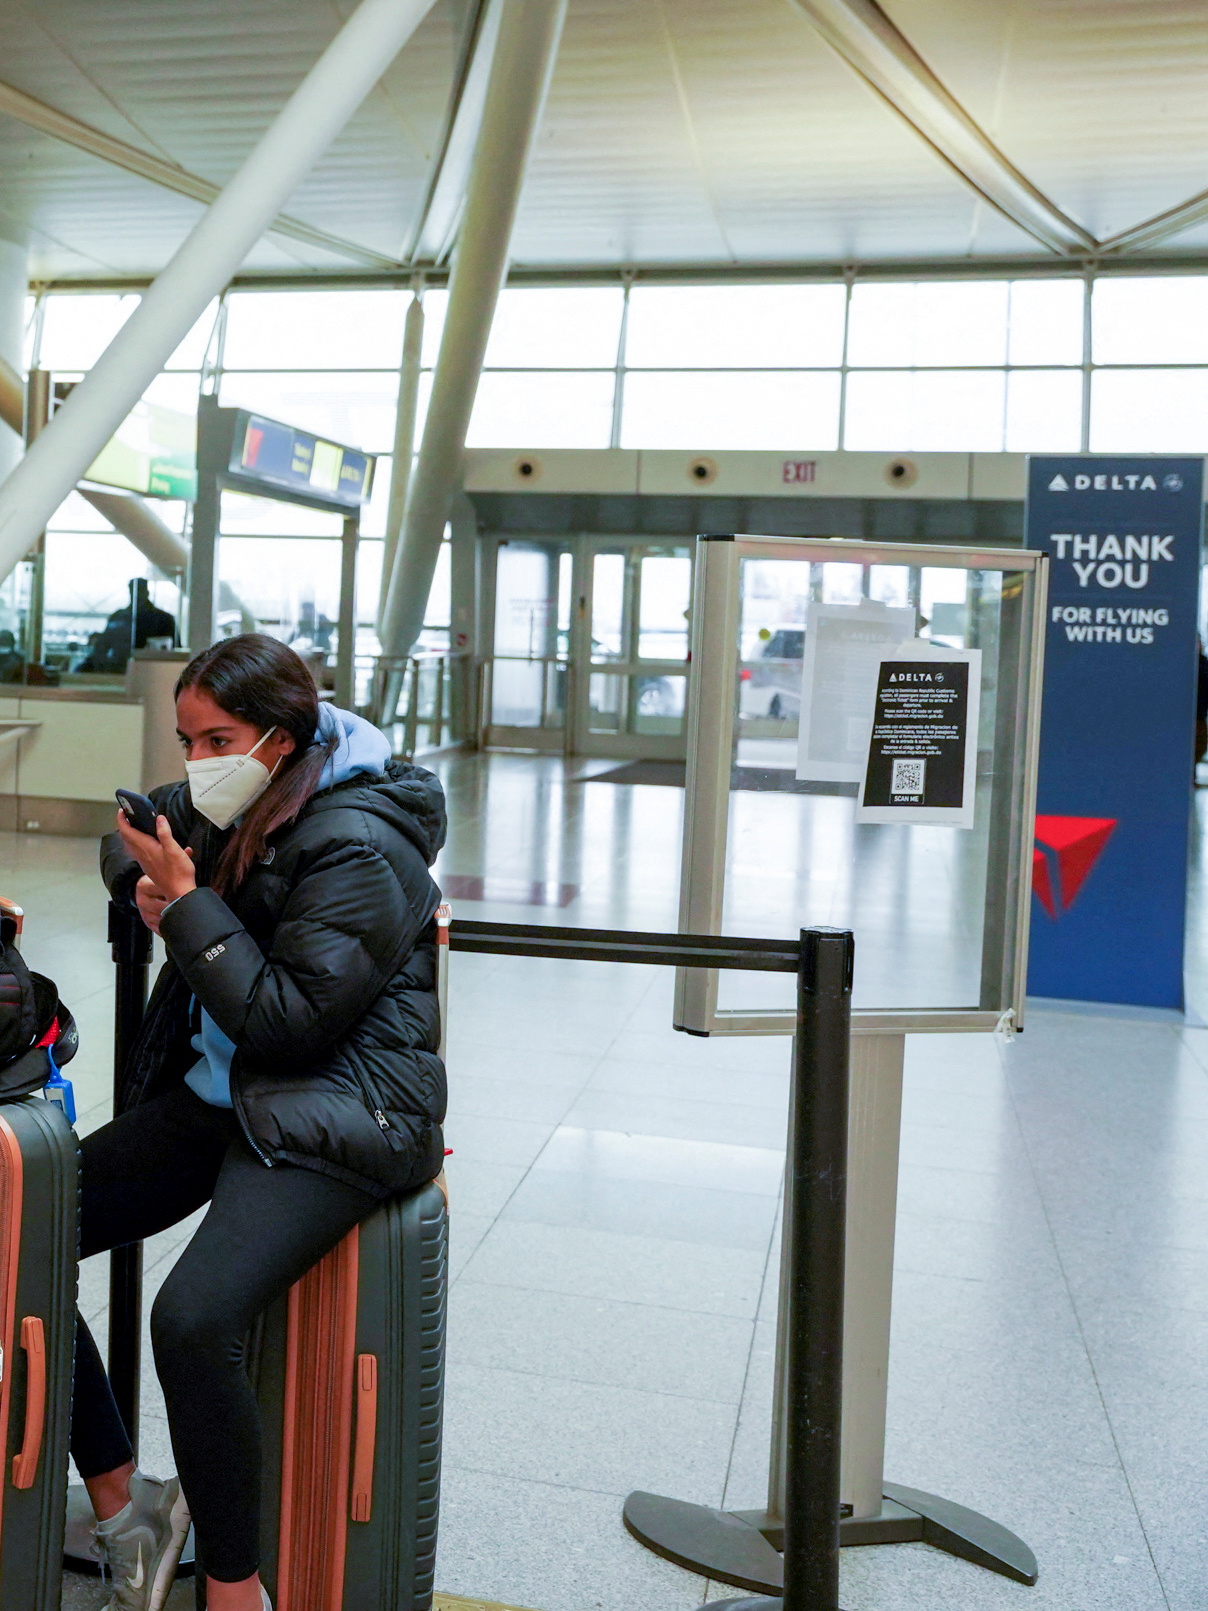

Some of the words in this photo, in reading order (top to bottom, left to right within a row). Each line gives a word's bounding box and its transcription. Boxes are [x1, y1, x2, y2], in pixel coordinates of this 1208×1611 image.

[783, 461, 817, 483] EXIT
[1074, 474, 1157, 491] DELTA
[1050, 533, 1175, 562] THANK
[1072, 562, 1149, 589] YOU
[1052, 606, 1092, 624] FOR
[1095, 607, 1169, 626] FLYING
[1065, 625, 1122, 643] WITH
[1126, 626, 1154, 644] US
[898, 672, 933, 682] DELTA
[204, 944, 226, 962] 550
